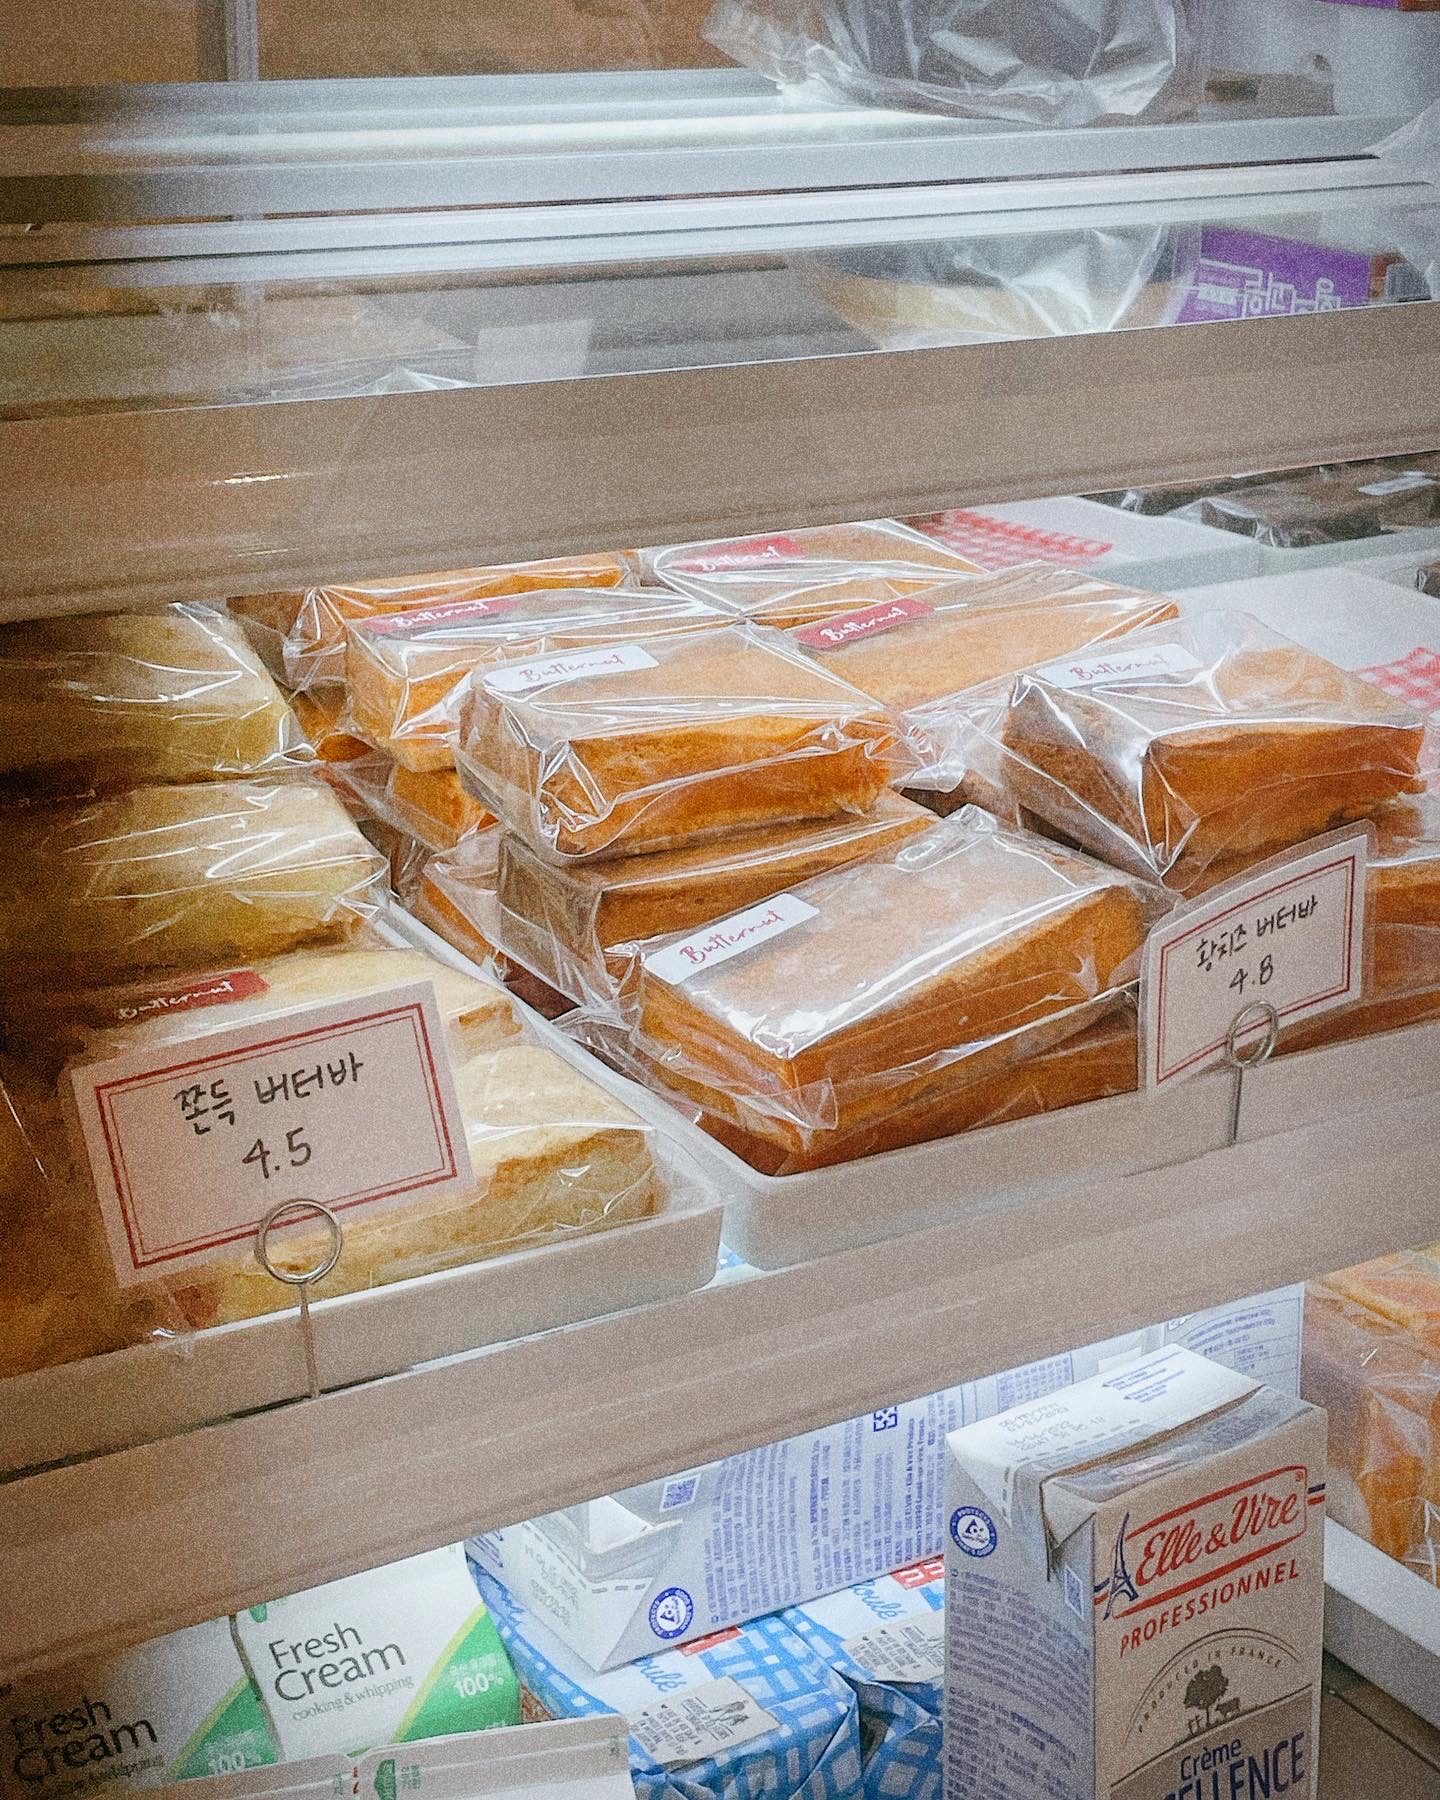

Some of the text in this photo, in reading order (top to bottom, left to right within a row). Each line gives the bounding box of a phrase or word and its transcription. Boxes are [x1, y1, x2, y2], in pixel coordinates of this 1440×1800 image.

[391, 600, 488, 629] Butternut
[820, 607, 907, 641] Butternut
[518, 653, 624, 683] Butternut
[1070, 655, 1168, 681] Butternut
[680, 909, 784, 964] Butternut
[1196, 895, 1318, 972] 황치즈 버터바
[1229, 954, 1274, 994] 4.8
[119, 980, 234, 1020] Butternut
[174, 1052, 364, 1135] 쫀득 버터바
[242, 1127, 311, 1179] 4.5
[1120, 1559, 1300, 1658] PROFESSIONNEL
[268, 1622, 363, 1669] Fresh
[274, 1643, 407, 1702] Cream
[356, 1675, 414, 1702] whipping
[451, 1671, 504, 1698] 100%
[1138, 1659, 1198, 1733] PRODUCED
[1231, 1646, 1281, 1669] FRANCE
[13, 1717, 158, 1783] Cream
[1180, 1738, 1242, 1782] Crème
